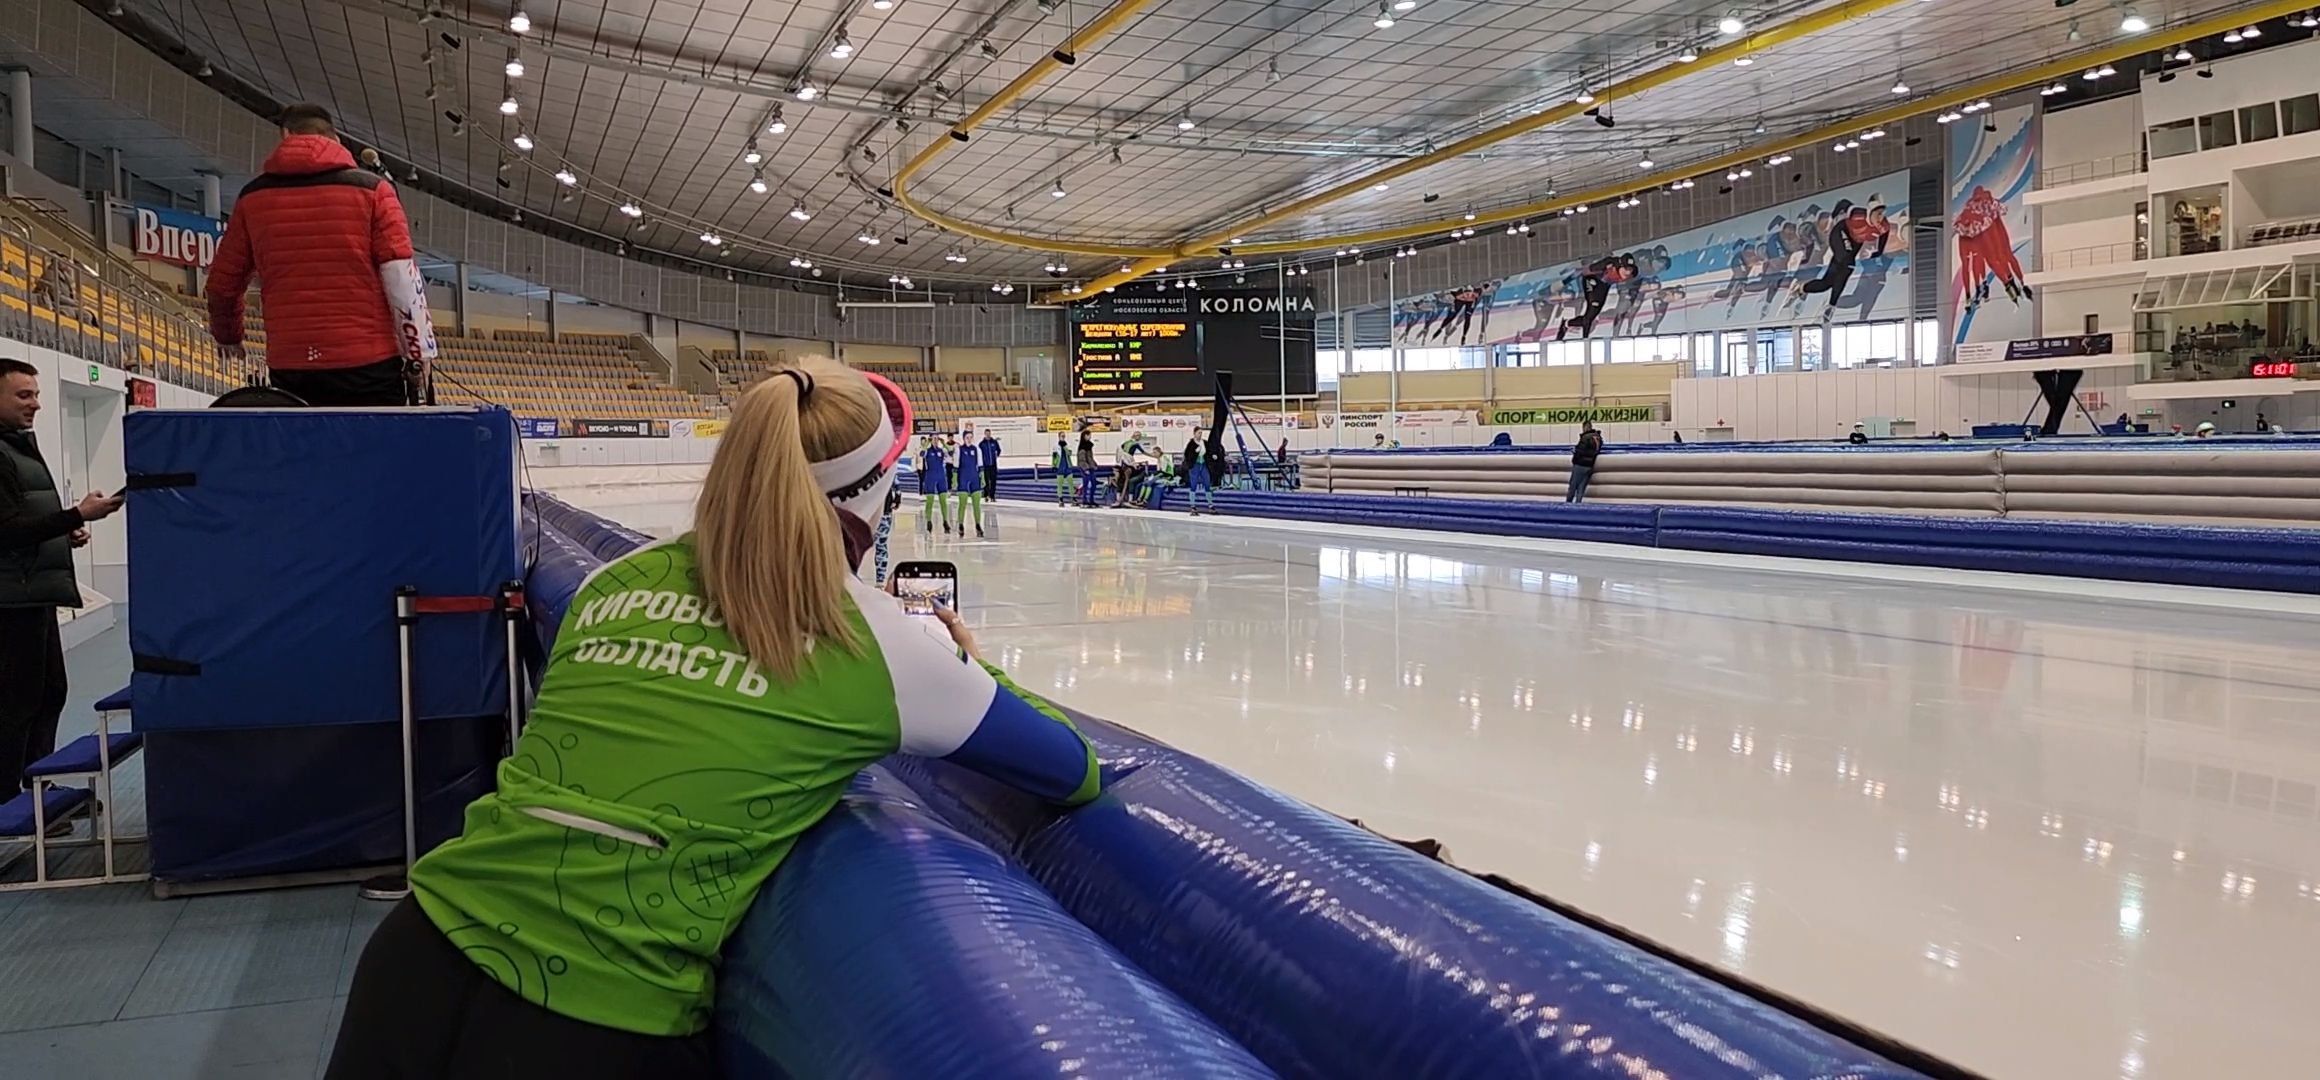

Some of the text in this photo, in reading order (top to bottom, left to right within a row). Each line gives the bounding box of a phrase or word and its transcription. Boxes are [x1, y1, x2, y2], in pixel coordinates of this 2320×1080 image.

[1201, 296, 1315, 313] КОЛОМНА
[1495, 408, 1650, 424] СПОРТ НОРМА ЖИЗНИ
[574, 636, 769, 698] ОБЛАСТЬ
